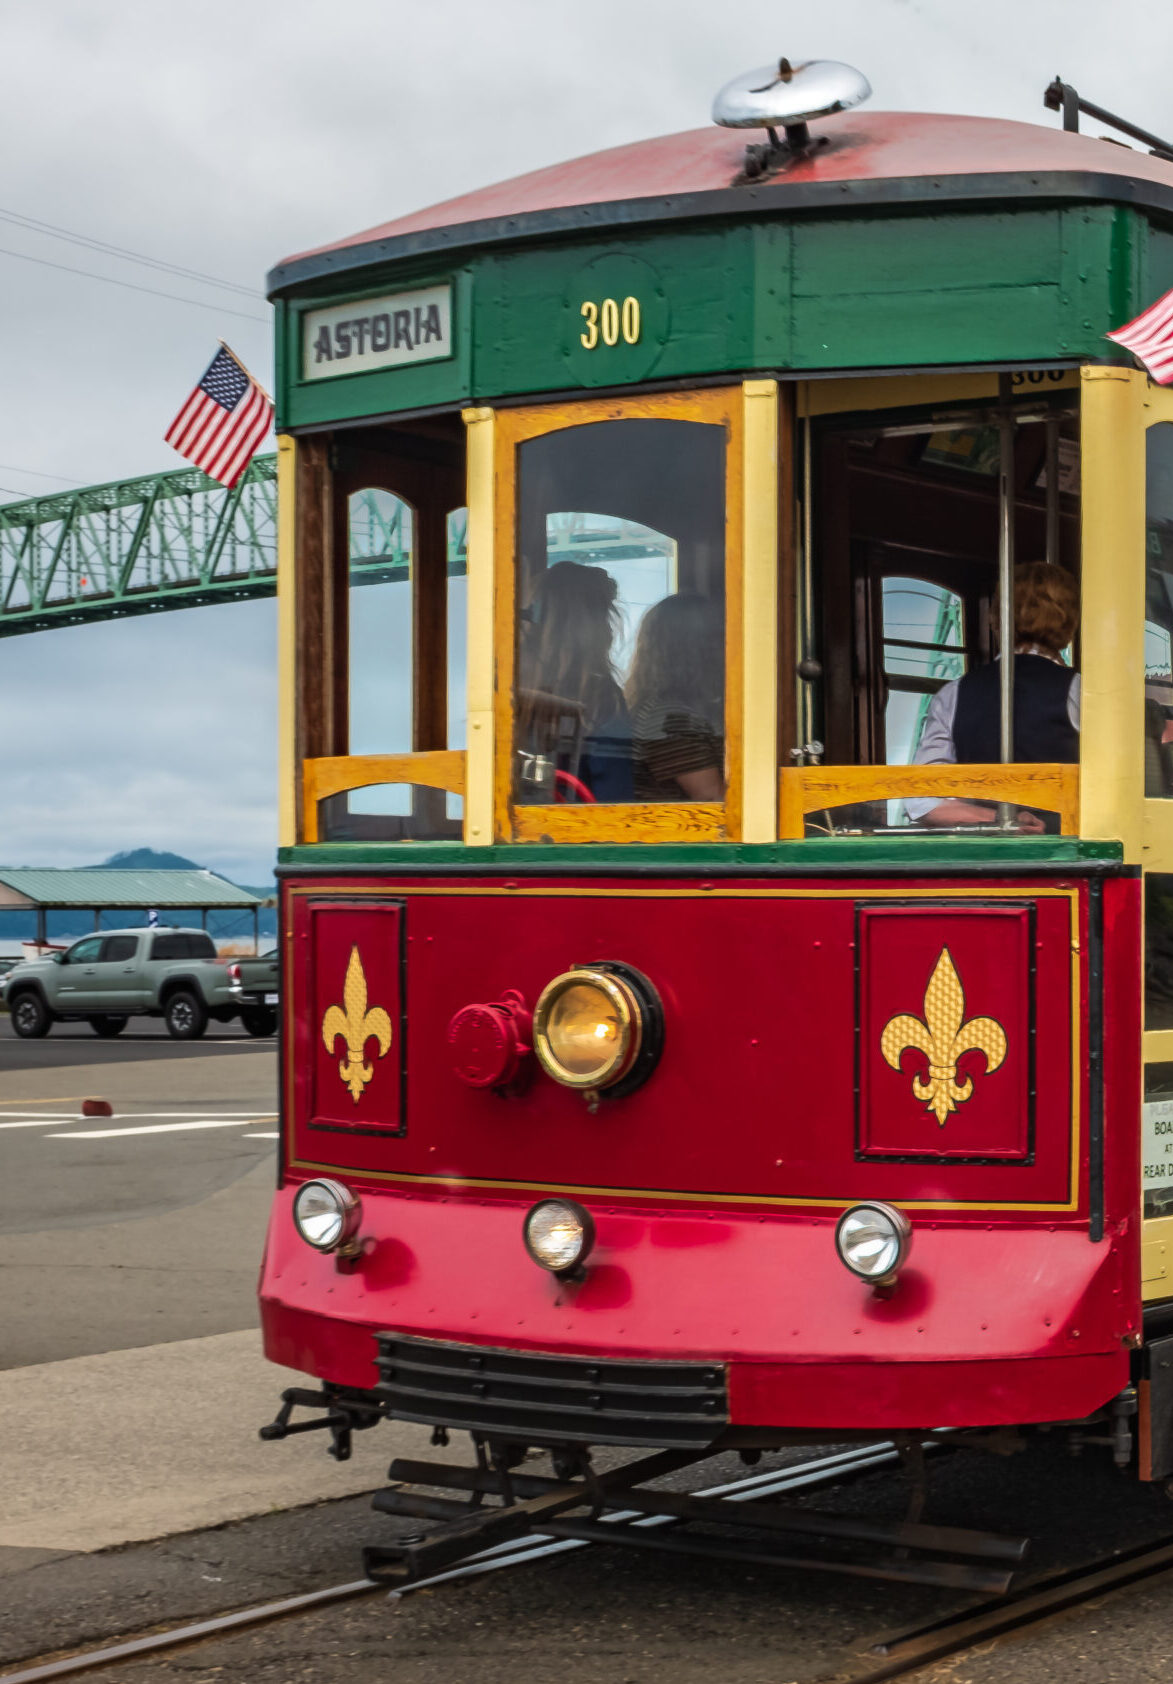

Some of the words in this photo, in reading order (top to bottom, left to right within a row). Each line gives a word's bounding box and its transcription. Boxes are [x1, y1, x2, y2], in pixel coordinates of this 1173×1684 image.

[314, 303, 443, 364] ASTORIA
[580, 296, 641, 350] 300
[1164, 1143, 1173, 1153] AT
[1144, 1163, 1166, 1178] REAR
